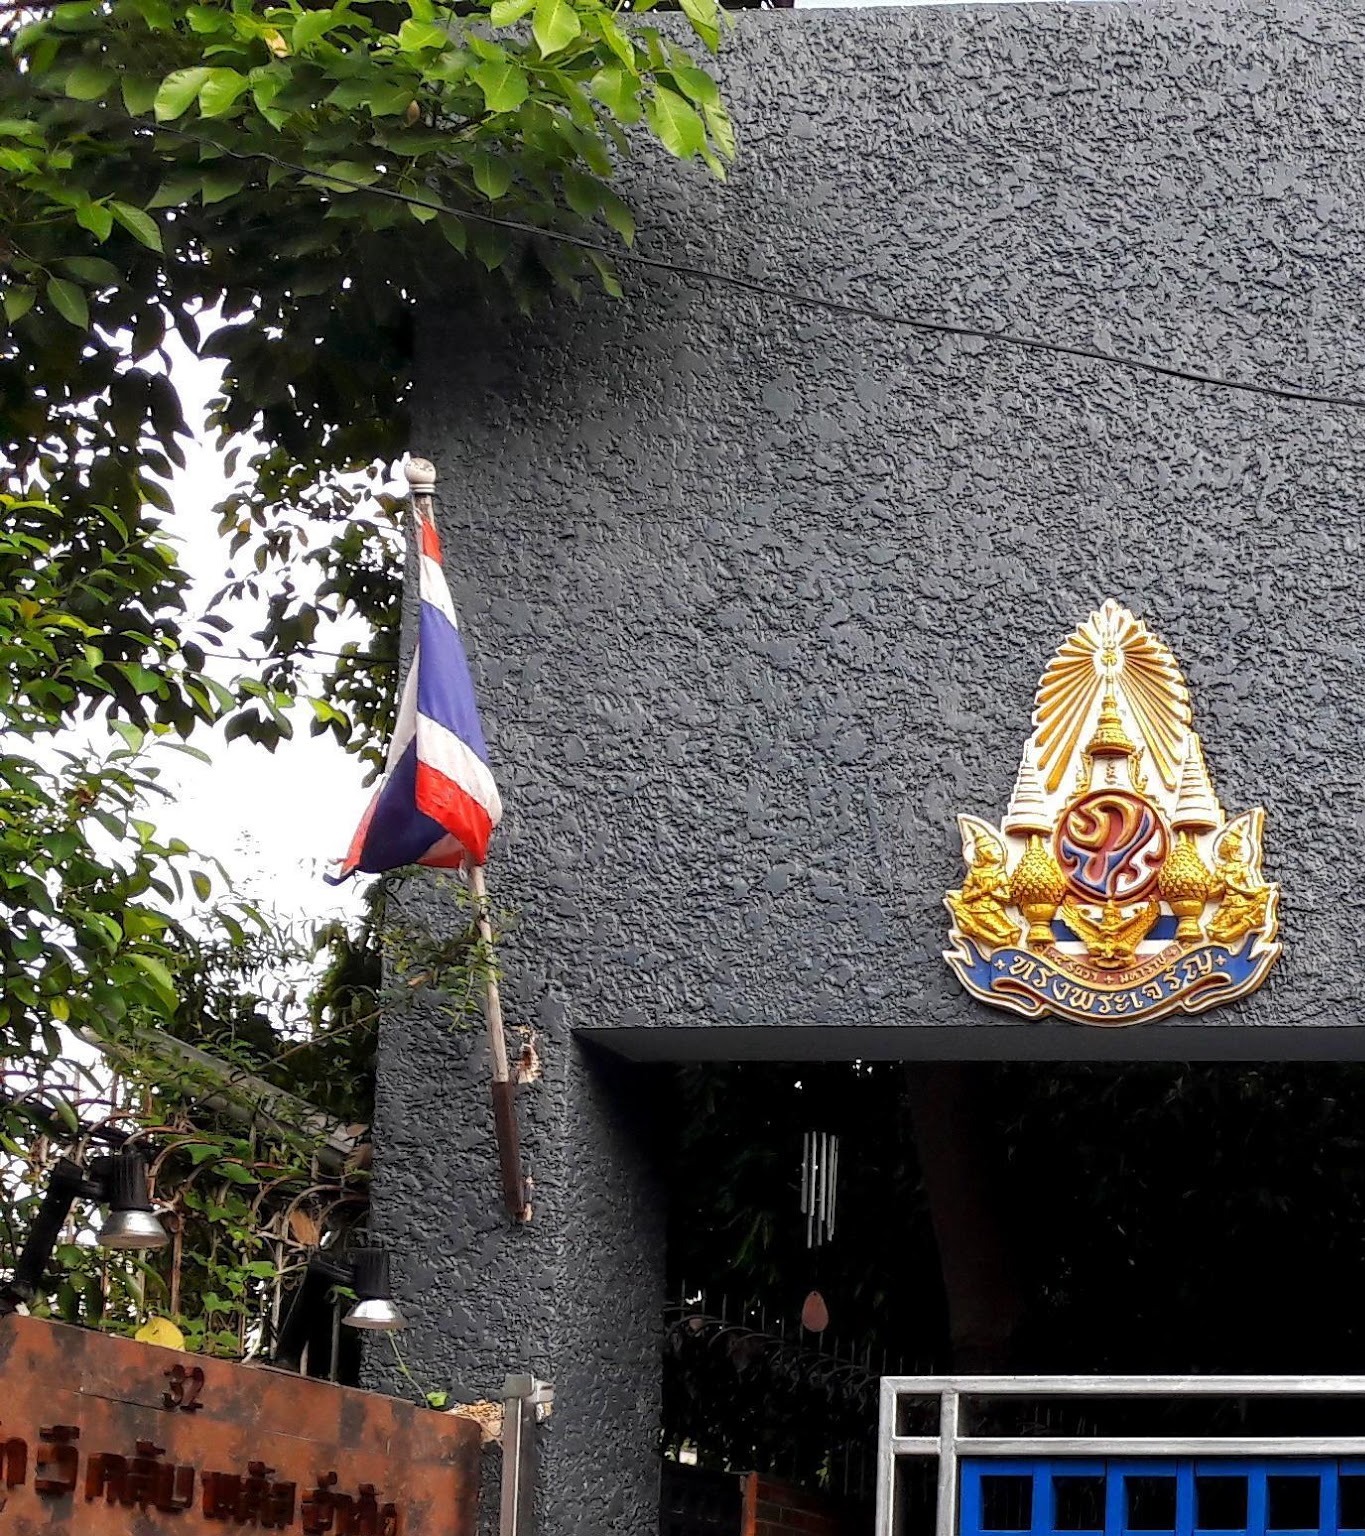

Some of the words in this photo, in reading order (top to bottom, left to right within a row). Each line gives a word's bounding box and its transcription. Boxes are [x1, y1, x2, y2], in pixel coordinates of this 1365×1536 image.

[1010, 948, 1213, 1014] ทรงพระเจริญ
[163, 1363, 204, 1412] 32
